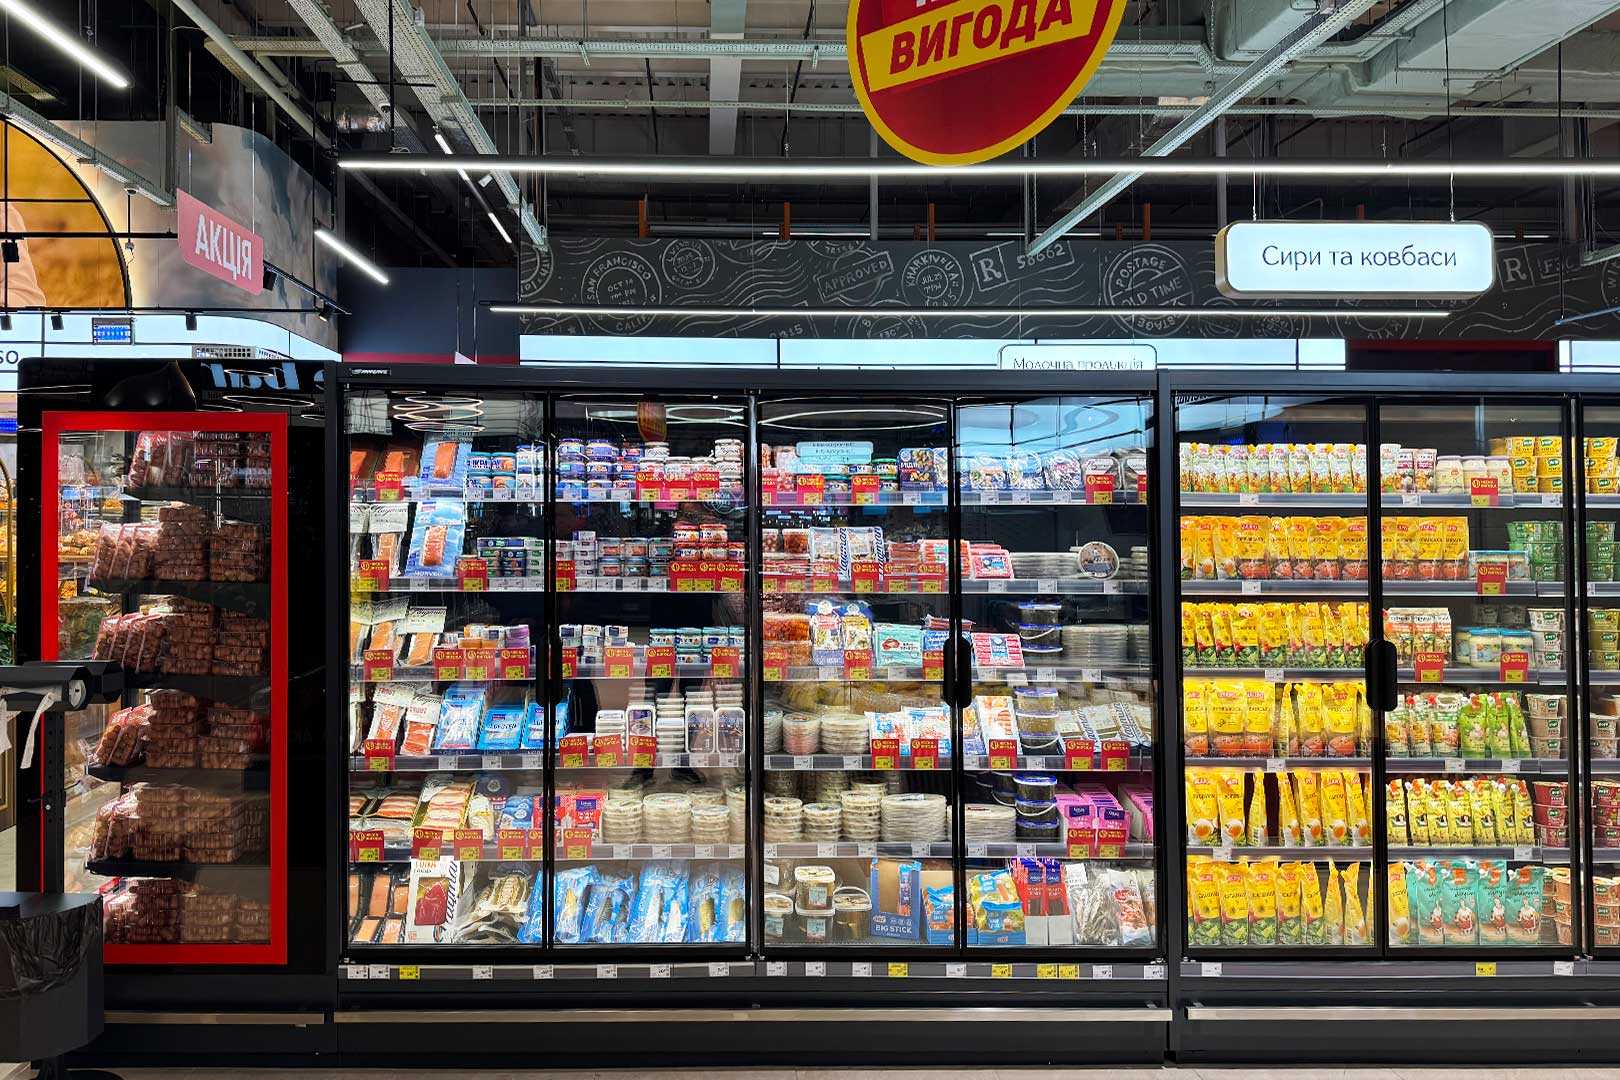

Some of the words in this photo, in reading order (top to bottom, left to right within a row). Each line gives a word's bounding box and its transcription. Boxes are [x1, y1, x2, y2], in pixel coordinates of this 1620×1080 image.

[889, 0, 1073, 74] ВИГОДА
[195, 213, 252, 281] АКЦІЯ
[1262, 245, 1322, 271] Сири
[1329, 252, 1354, 267] та
[1361, 245, 1457, 267] ковбаси
[593, 256, 652, 281] FRANCISCO
[824, 260, 888, 292] APPROVED
[905, 254, 941, 287] KHARKIV
[978, 257, 1002, 282] R
[1116, 256, 1167, 288] POSTAGE
[1504, 257, 1527, 283] R
[1149, 276, 1183, 299] TIME
[875, 924, 889, 932] BIG
[889, 925, 912, 933] STICK
